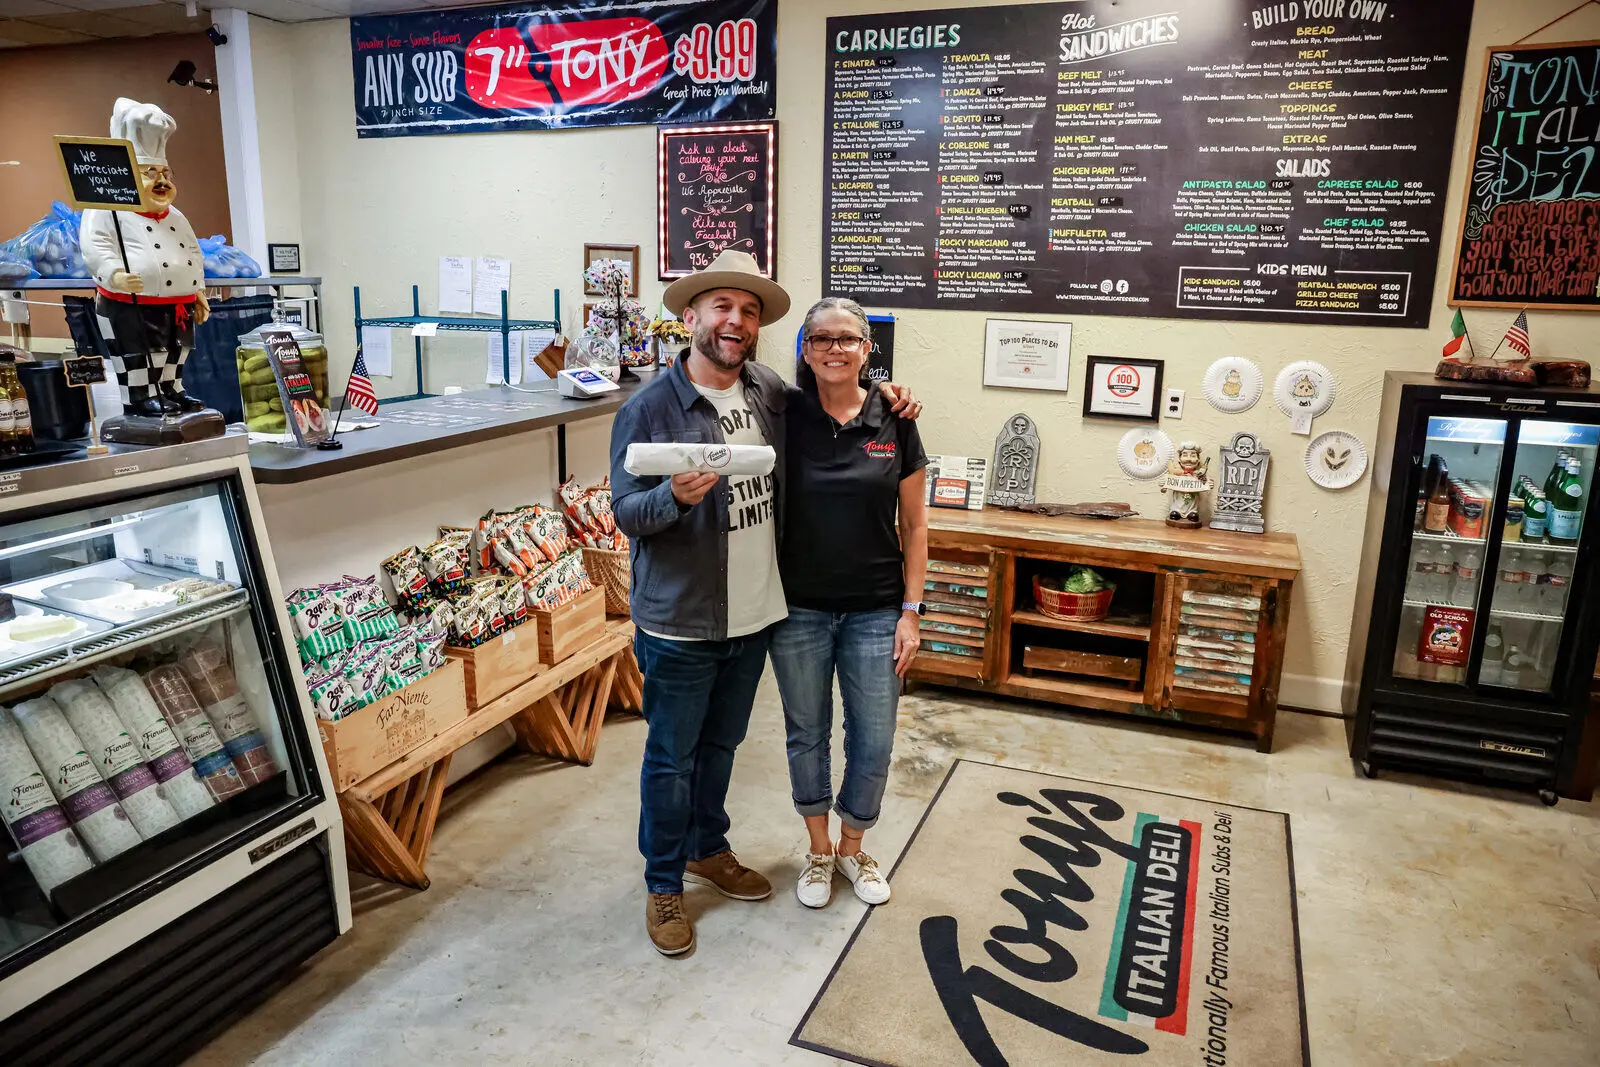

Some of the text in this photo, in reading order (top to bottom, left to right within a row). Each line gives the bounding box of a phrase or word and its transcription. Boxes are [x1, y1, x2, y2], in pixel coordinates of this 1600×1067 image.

[1252, 0, 1387, 29] BUILD YOUR OWN
[1061, 13, 1096, 31] Hot
[1296, 25, 1335, 36] BREAD
[432, 30, 461, 47] Flavors
[835, 23, 961, 52] CARNEGIES
[1059, 15, 1179, 62] SANDWICHES
[673, 17, 758, 83] $9.99
[1298, 49, 1329, 59] MEAT
[950, 53, 990, 62] TRAVOLTA
[842, 59, 875, 68] SINATRA
[364, 50, 458, 107] ANY SUB
[1057, 70, 1102, 80] BEEF MELT
[663, 80, 767, 100] Great Price You Wanted!
[1288, 80, 1333, 90] CHEESE
[842, 90, 869, 99] PACINO
[953, 88, 981, 96] DANZA
[391, 106, 443, 117] INCH SIZE
[1056, 102, 1114, 112] TURKEY MELT
[1280, 103, 1337, 113] TOPPINGS
[842, 120, 880, 129] STALLONE
[952, 115, 981, 123] DEVITO
[1492, 106, 1600, 147] ITAL
[1054, 135, 1096, 144] HAM MELT
[1282, 134, 1328, 144] EXTRAS
[678, 141, 748, 155] Ask us about
[948, 141, 990, 149] CORLEONE
[79, 149, 97, 163] We
[679, 153, 760, 167] catering your next
[840, 151, 869, 159] MARTIN
[73, 162, 129, 175] Appreciate
[1053, 166, 1115, 175] CHICKEN PARM
[1275, 158, 1331, 178] SALADS
[950, 174, 980, 183] DENIRO
[1317, 180, 1363, 189] CAPRESE
[1365, 179, 1399, 189] SALAD
[1182, 180, 1266, 189] ANTIPASTA SALAD
[681, 184, 748, 197] We Appreciate
[1051, 198, 1094, 207] MEATBALL
[692, 216, 737, 229] Like us on
[1184, 223, 1224, 232] CHICKEN
[1226, 224, 1257, 232] SALAD
[1323, 218, 1349, 227] CHEF
[1351, 218, 1385, 227] SALAD
[695, 228, 737, 240] Facebook!
[1053, 229, 1107, 238] MUFFULETTA
[1482, 223, 1586, 240] may forget
[838, 235, 882, 243] GANDOLFINI
[939, 238, 1009, 247] ROCKY MARCIANO
[1467, 236, 1592, 260] you but
[1256, 263, 1327, 276] KIDS MENU
[1513, 255, 1576, 274] never
[938, 271, 1001, 279] LUCKY LUCIANO
[1202, 278, 1240, 286] SANDWICH
[1297, 281, 1401, 291] MEATBALL SANDWICH $5.00
[1496, 273, 1528, 296] you
[1319, 301, 1360, 309] SANDWICH
[1000, 338, 1011, 346] TOP
[1021, 336, 1041, 345] PLACES
[1048, 340, 1059, 349] EAT
[274, 345, 299, 360] Tony's
[868, 366, 889, 379] eats
[1116, 373, 1133, 384] 100
[863, 440, 896, 454] Tony's
[707, 447, 727, 462] Tony's
[1226, 465, 1258, 486] RIP
[1166, 477, 1179, 487] BON
[1444, 614, 1469, 622] SCHOOL
[376, 702, 397, 730] Far
[1213, 810, 1232, 834] Deli
[1214, 835, 1231, 845] &
[1211, 844, 1231, 876] Subs
[1209, 877, 1230, 922] Italian
[1126, 828, 1182, 1006] ITALIAN DELI
[919, 788, 1150, 1067] Tony's
[1205, 923, 1230, 990] Famous
